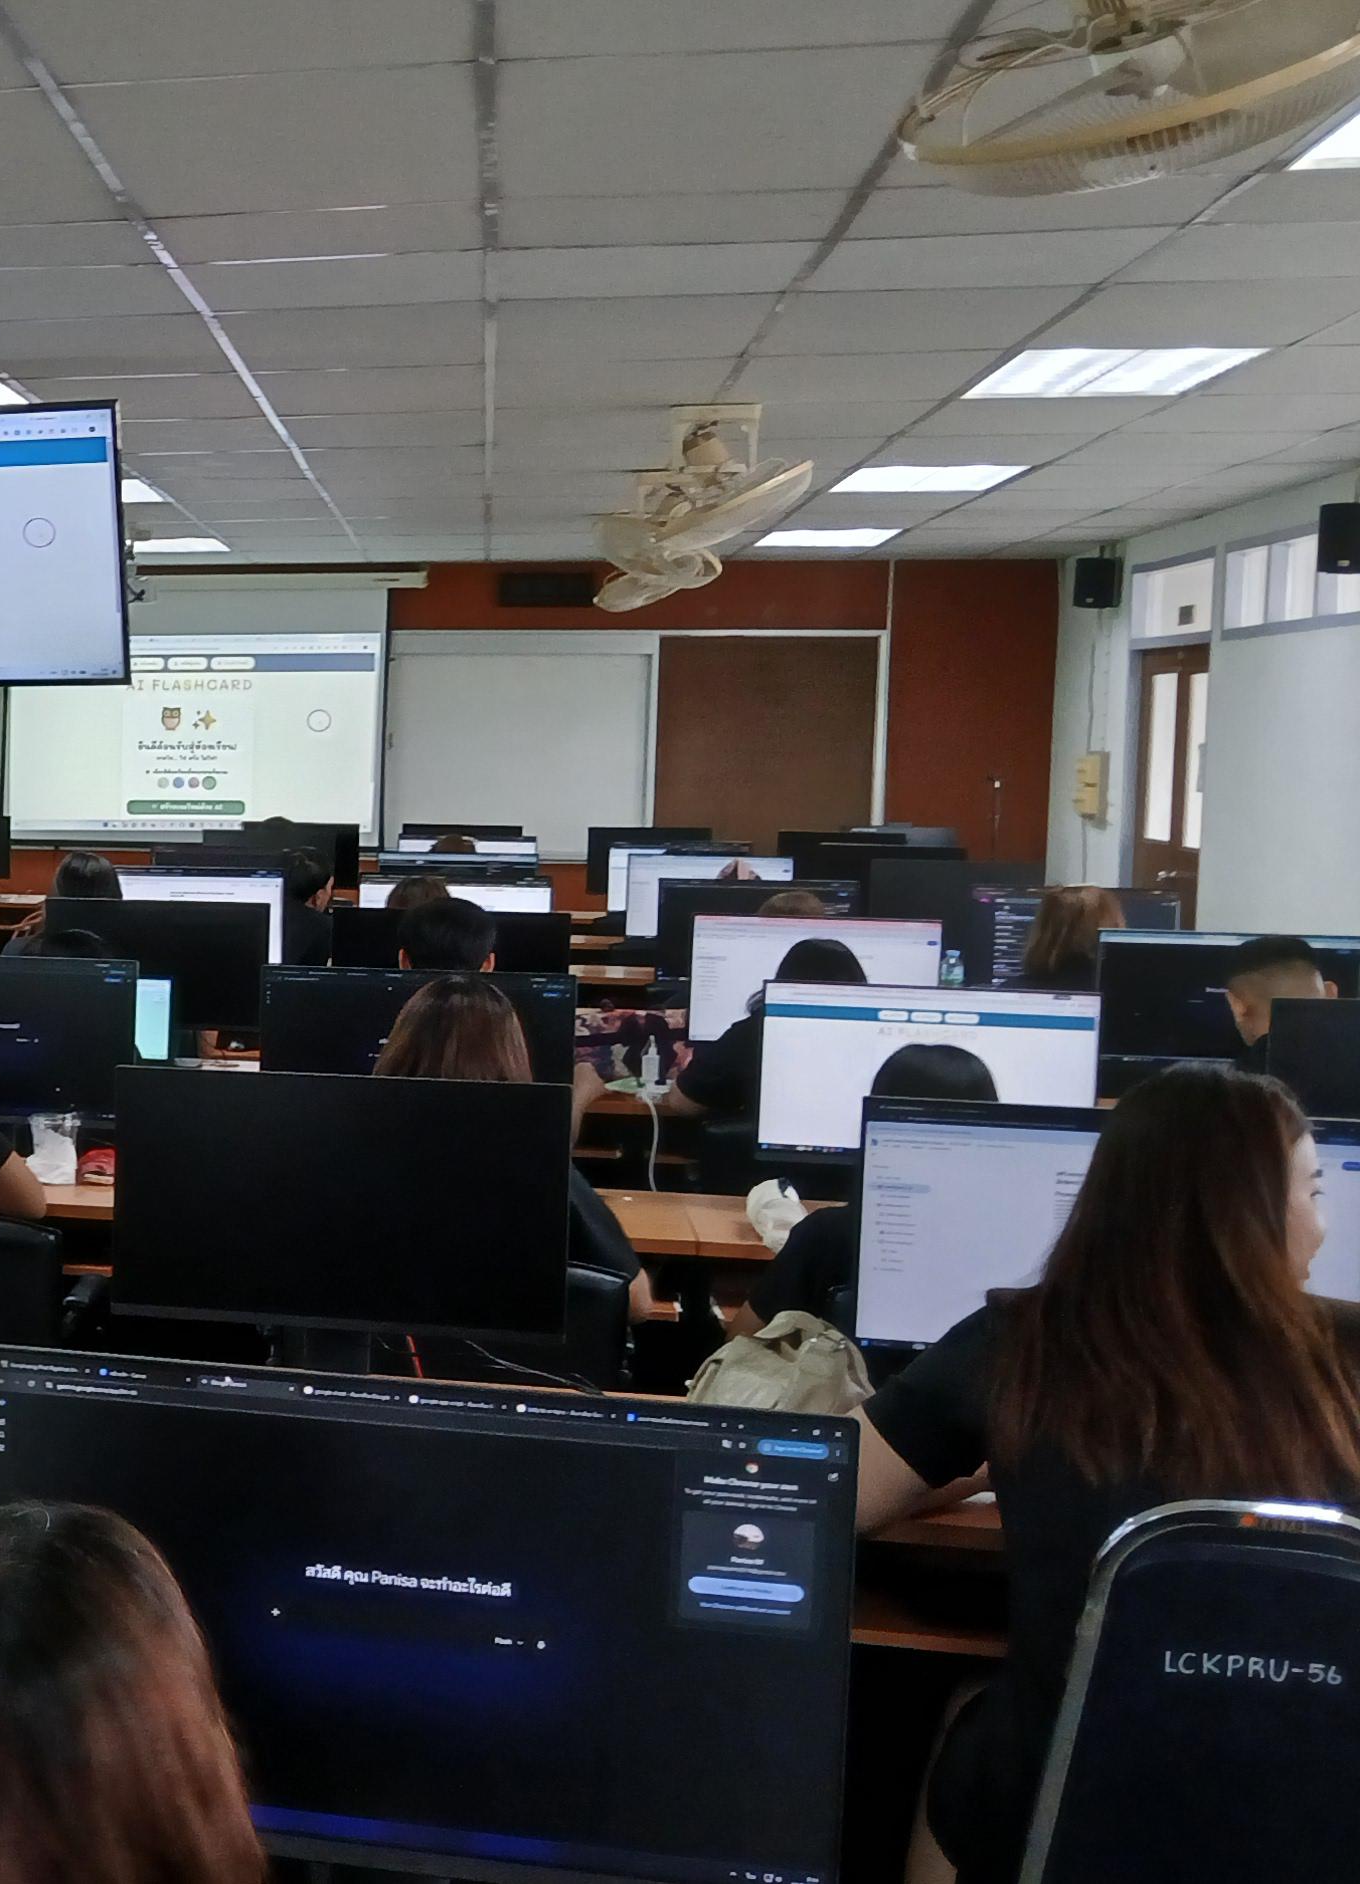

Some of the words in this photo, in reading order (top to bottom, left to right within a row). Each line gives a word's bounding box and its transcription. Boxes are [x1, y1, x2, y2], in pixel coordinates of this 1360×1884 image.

[152, 679, 253, 691] FLASHCARD
[305, 1563, 342, 1580] สวัสดี
[344, 1570, 369, 1586] คุณ
[371, 1571, 418, 1589] Panisa
[420, 1576, 512, 1598] จะทำอะไรต่อดี
[1164, 1650, 1343, 1685] LCKPRU-56
